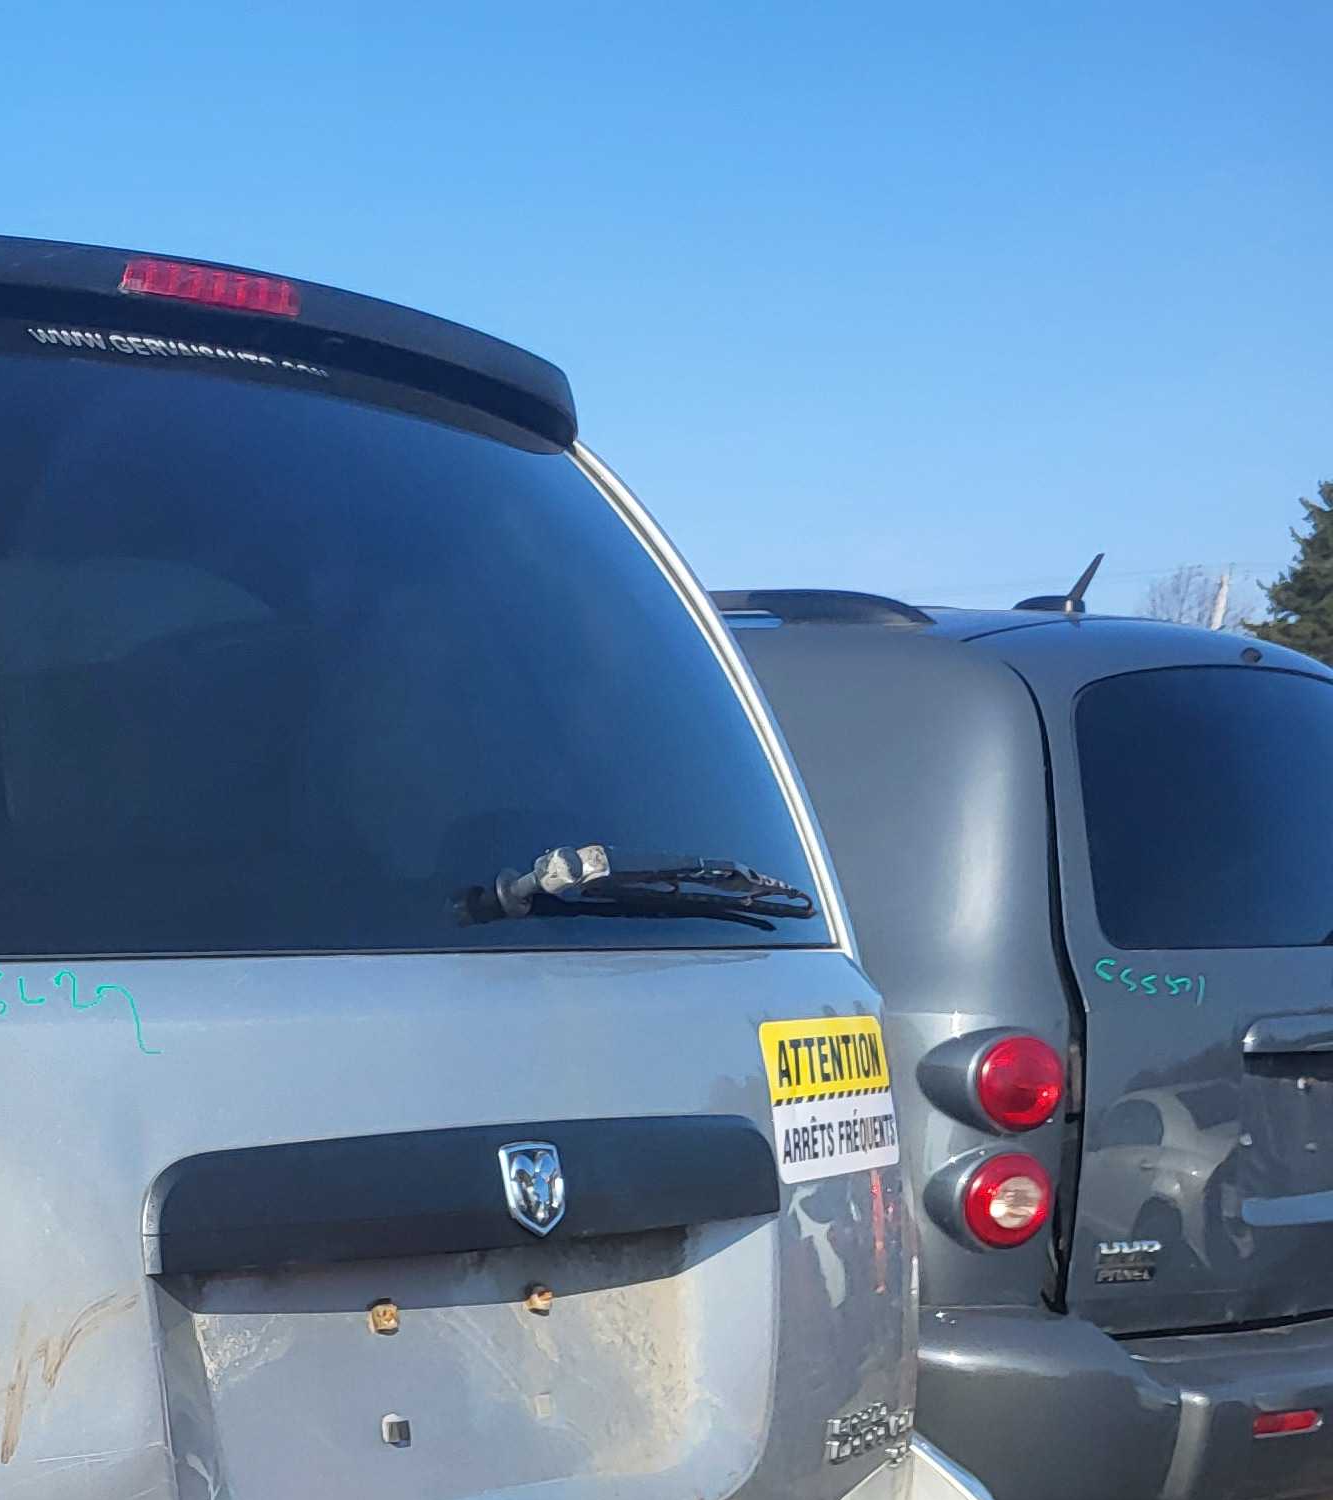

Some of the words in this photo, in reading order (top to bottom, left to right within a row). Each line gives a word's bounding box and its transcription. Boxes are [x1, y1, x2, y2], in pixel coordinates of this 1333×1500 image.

[778, 1033, 881, 1088] ATTENTION
[783, 1116, 833, 1164] ARRÊTS
[838, 1109, 896, 1154] FRÉQUENTS
